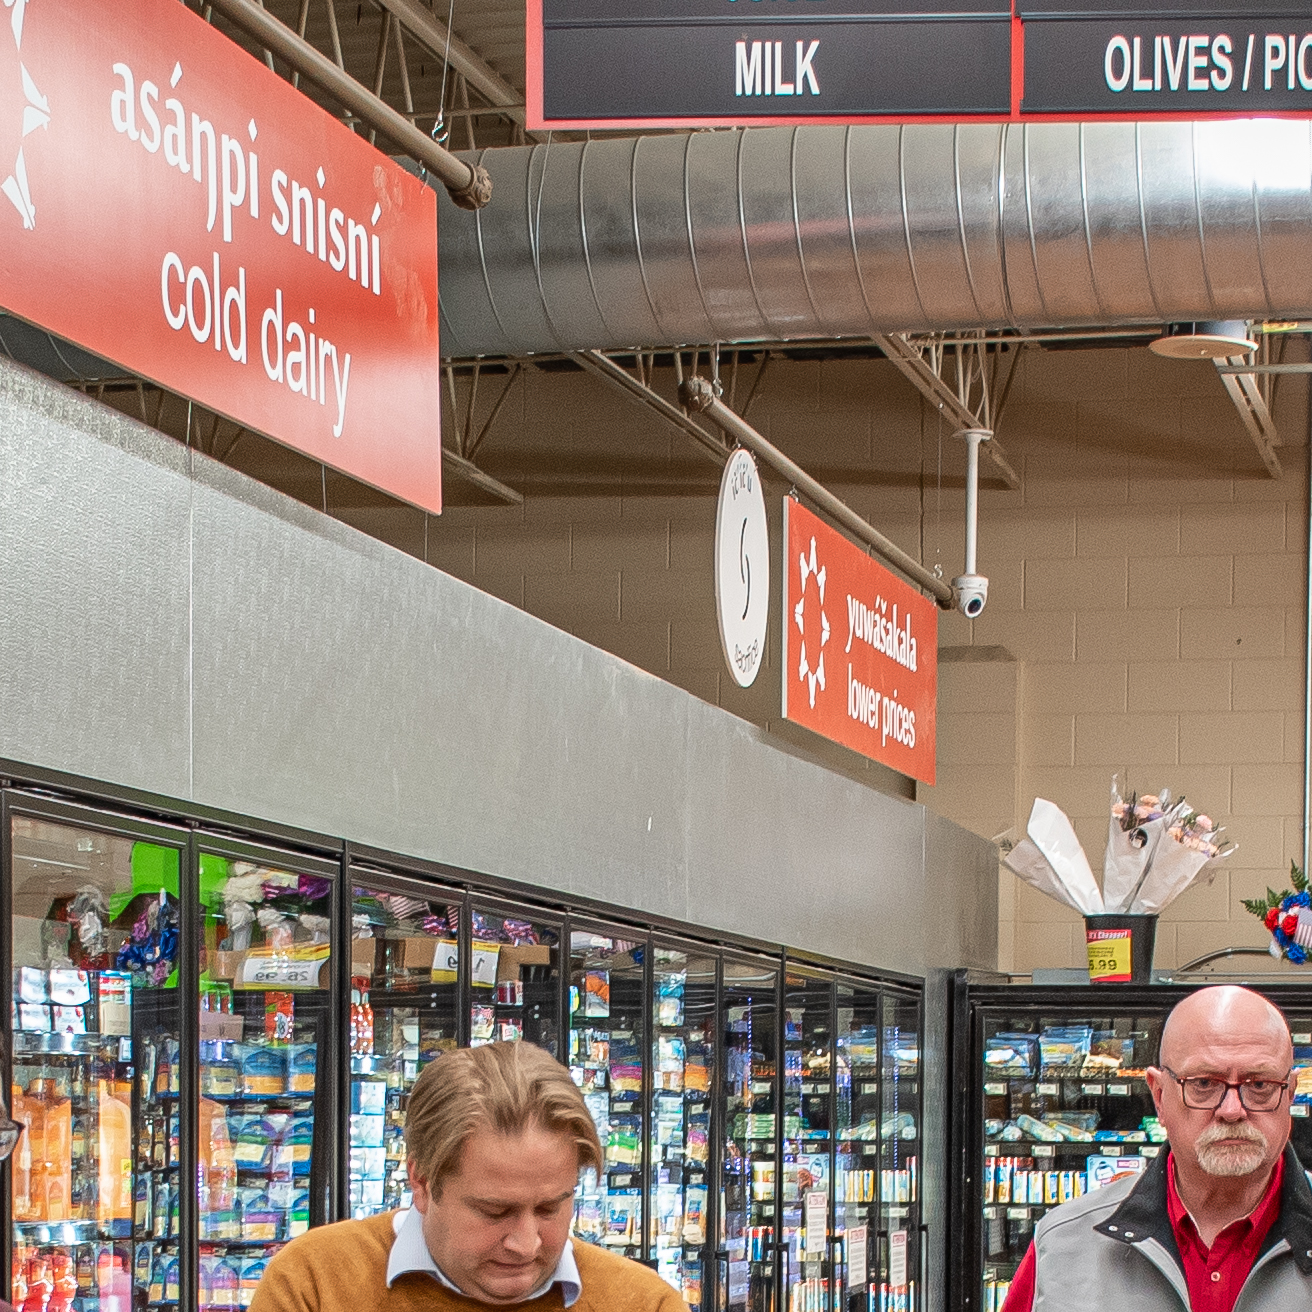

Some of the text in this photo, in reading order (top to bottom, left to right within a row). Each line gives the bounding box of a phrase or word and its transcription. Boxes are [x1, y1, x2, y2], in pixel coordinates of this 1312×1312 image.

[735, 39, 820, 97] MILK
[1104, 34, 1233, 92] OLIVES
[1241, 34, 1255, 91] /
[271, 165, 382, 296] snisní
[161, 251, 351, 438] cold dairy
[847, 662, 916, 748] lower prices
